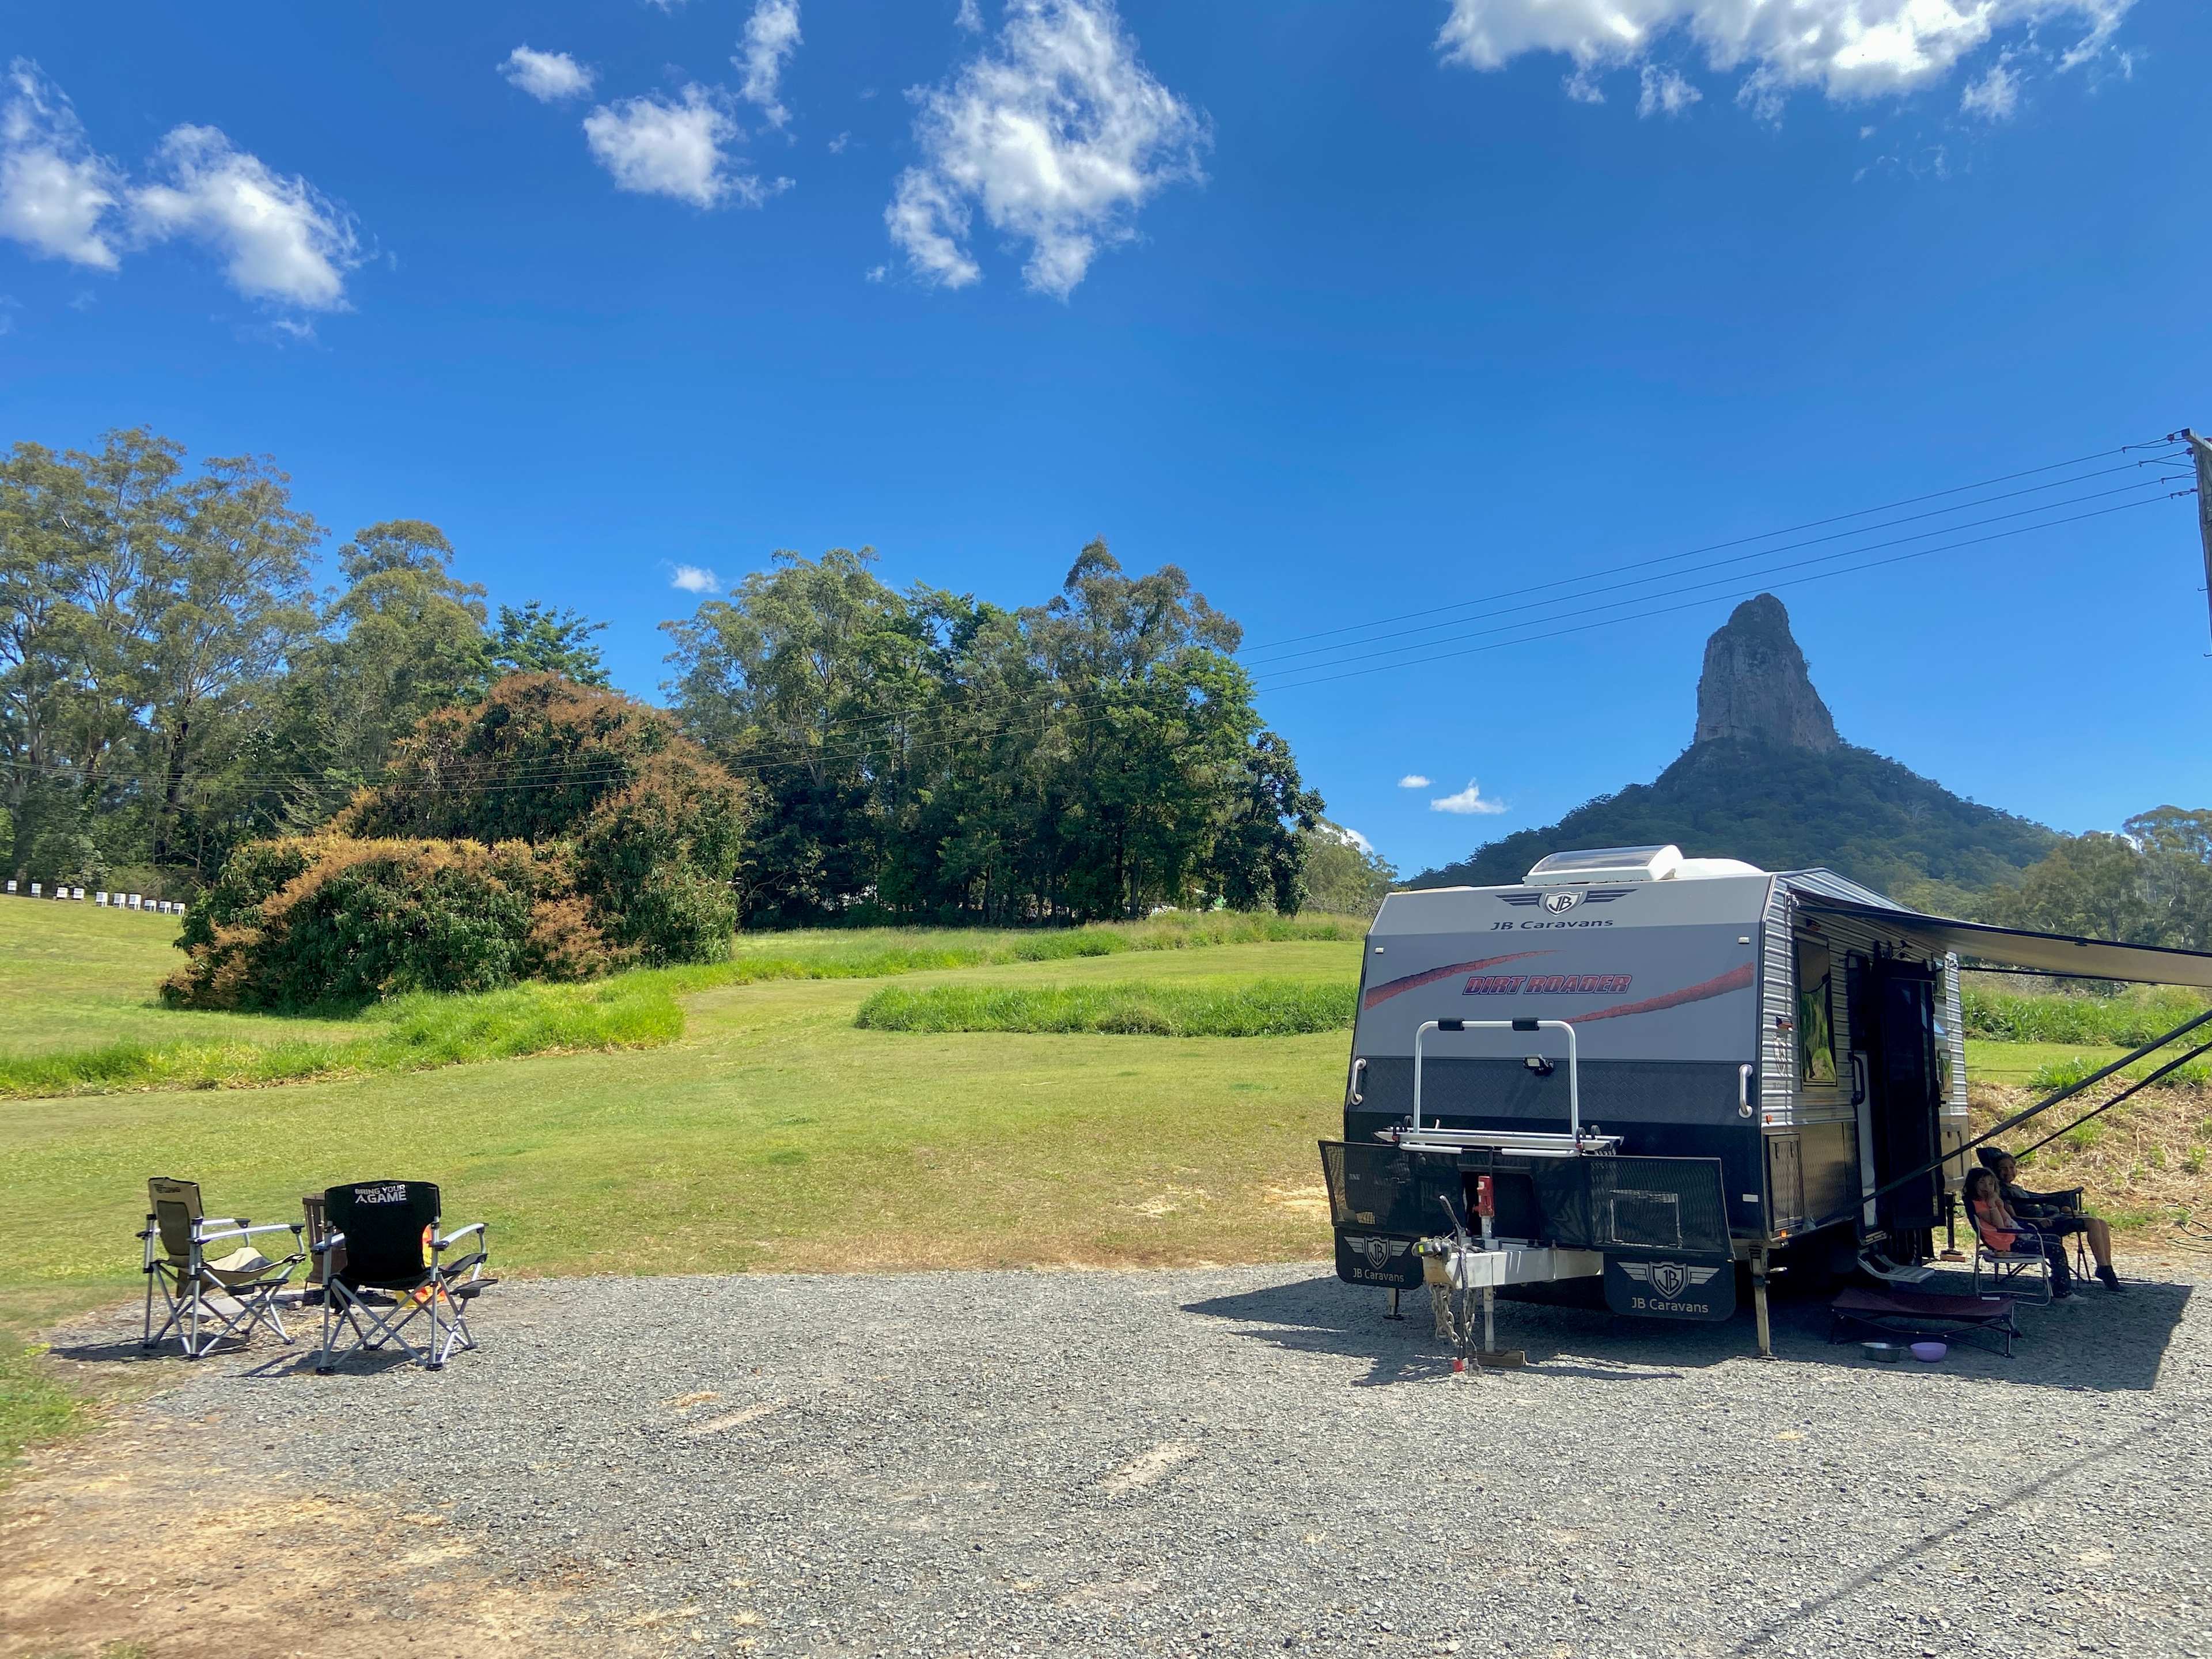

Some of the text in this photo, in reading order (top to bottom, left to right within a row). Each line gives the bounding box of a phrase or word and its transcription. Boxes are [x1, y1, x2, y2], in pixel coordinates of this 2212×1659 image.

[1548, 895, 1573, 912] JB
[1490, 920, 1613, 930] JB Caravans
[1463, 974, 1633, 995] DIRT ROADER
[382, 1184, 406, 1194] YOUR
[1370, 1243, 1384, 1264] JB
[1353, 1267, 1404, 1282] JB Caravans
[1657, 1269, 1679, 1291] JB
[1631, 1297, 1709, 1313] JB Caravans
